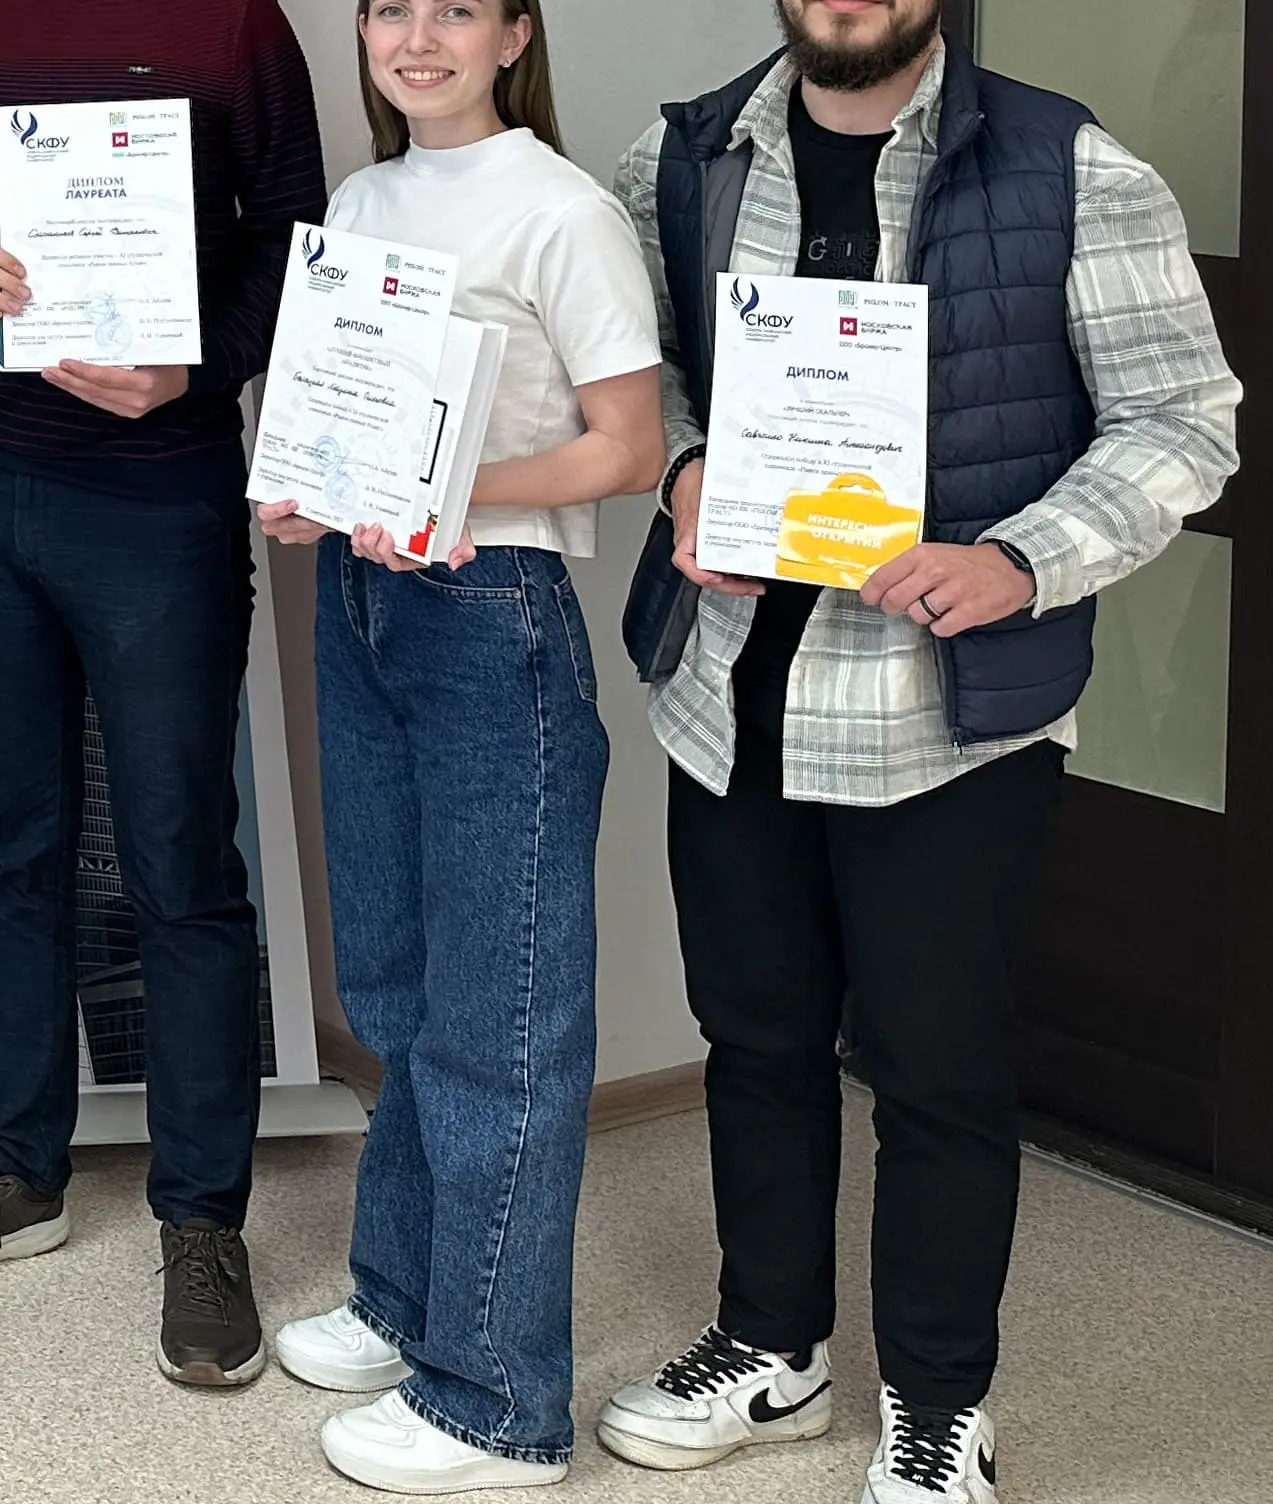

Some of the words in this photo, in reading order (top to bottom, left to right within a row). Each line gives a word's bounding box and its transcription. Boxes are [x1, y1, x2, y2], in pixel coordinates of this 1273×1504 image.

[25, 136, 70, 150] СКФУ
[67, 176, 125, 188] ДИПЛОМ
[65, 188, 127, 200] ЛАУРЕАТА
[310, 263, 349, 281] СКФУ
[334, 317, 383, 337] ДИПЛОМ
[745, 313, 794, 328] СКФУ
[786, 366, 849, 382] ДИПЛОМ
